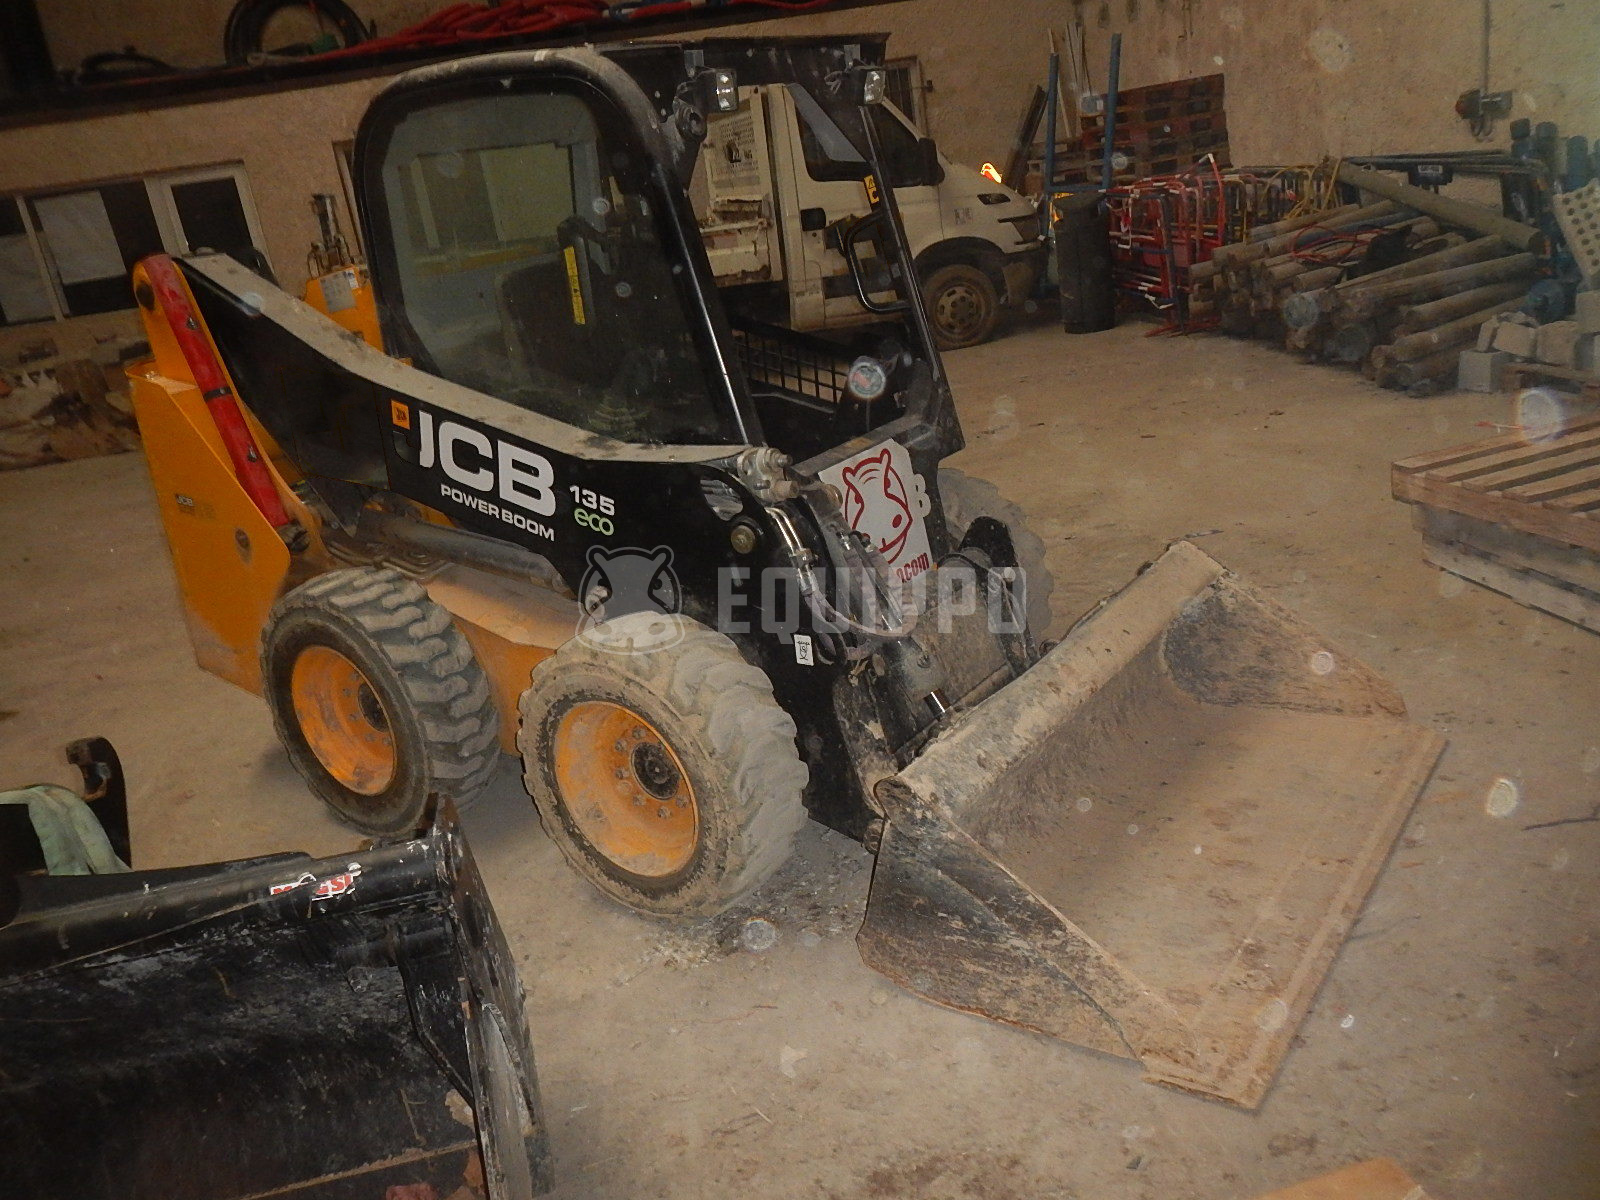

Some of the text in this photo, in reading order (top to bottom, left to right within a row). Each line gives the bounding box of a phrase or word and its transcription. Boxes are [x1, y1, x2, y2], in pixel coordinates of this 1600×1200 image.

[418, 410, 556, 517] JCB
[569, 485, 615, 516] 135
[574, 508, 614, 536] eco
